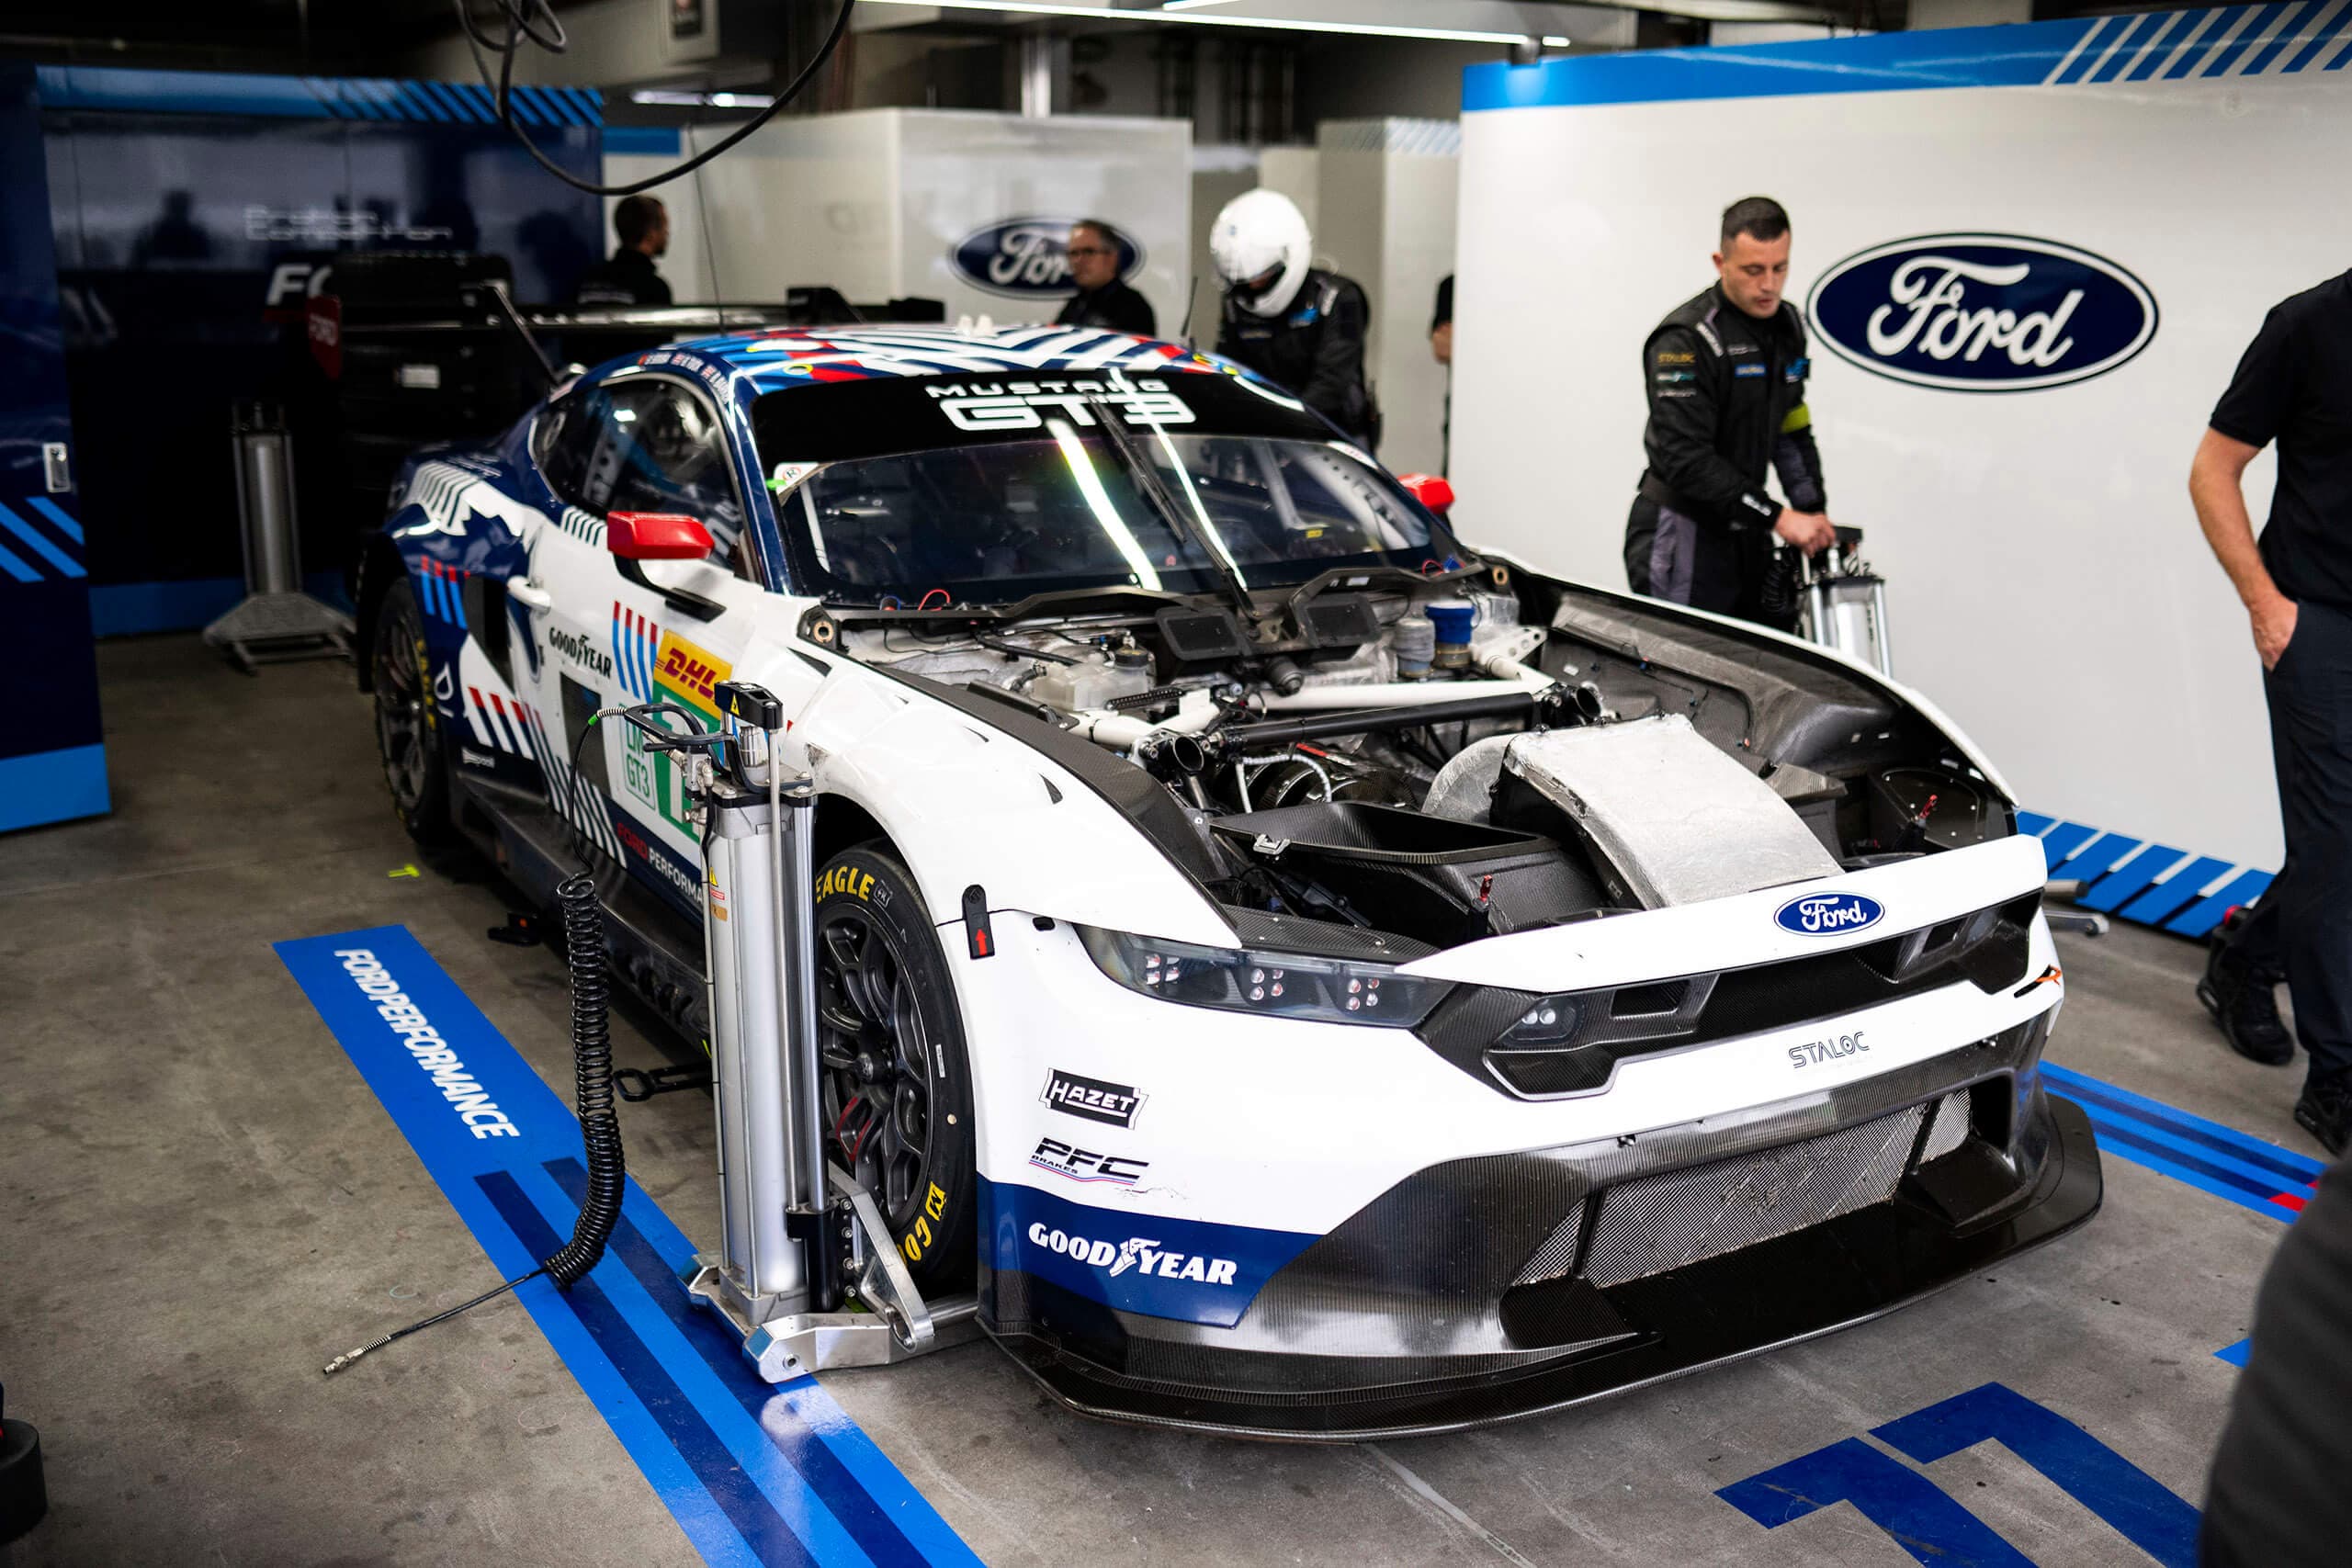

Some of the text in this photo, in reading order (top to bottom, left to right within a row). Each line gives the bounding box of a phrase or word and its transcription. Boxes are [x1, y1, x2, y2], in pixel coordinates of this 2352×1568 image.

[989, 226, 1072, 285] For
[1867, 255, 2085, 367] Ford
[924, 378, 1170, 398] MUSTANG
[939, 392, 1197, 432] GT3
[548, 626, 613, 680] GOODYEAR
[662, 647, 717, 699] DHL
[626, 753, 651, 799] GT3
[617, 821, 704, 905] FORD PERFORMA
[816, 865, 876, 904] EAGLE
[1798, 897, 1868, 931] Ford
[1788, 1031, 1871, 1069] STALOC
[1048, 1078, 1140, 1111] HAZET
[1031, 1154, 1079, 1175] BRAKES
[1035, 1136, 1150, 1179] PFC
[1028, 1222, 1238, 1286] GOODYEAR
